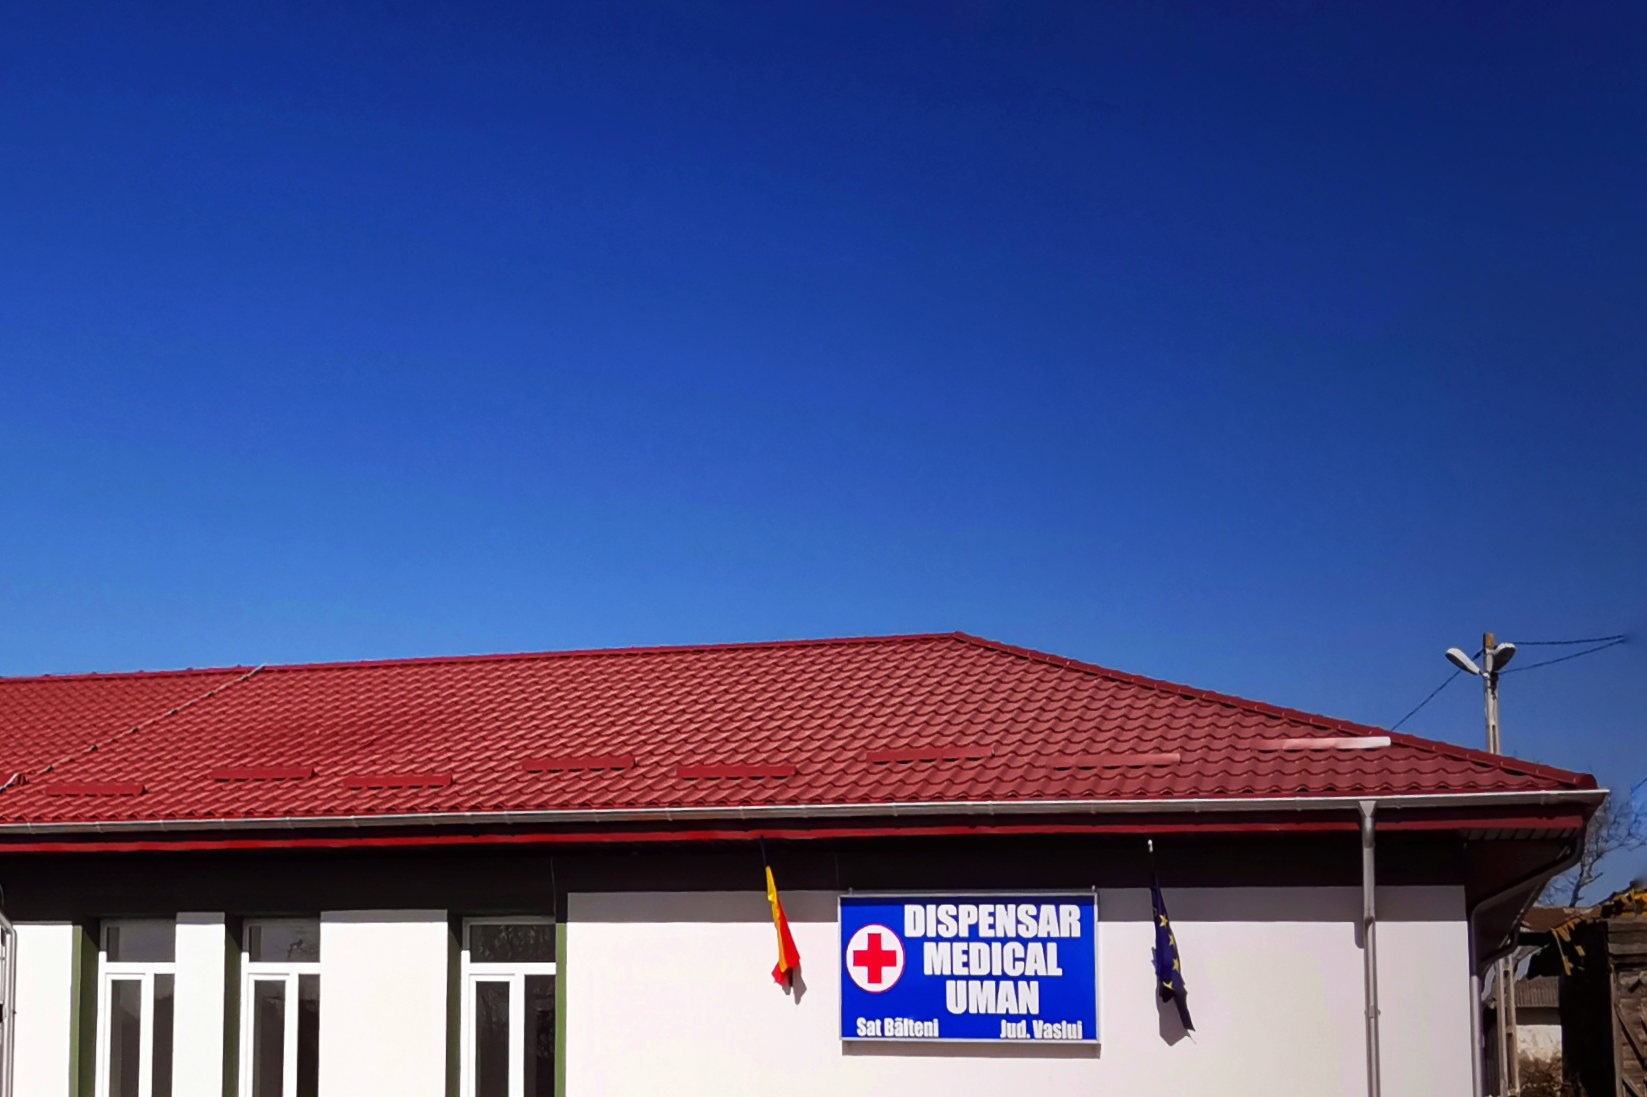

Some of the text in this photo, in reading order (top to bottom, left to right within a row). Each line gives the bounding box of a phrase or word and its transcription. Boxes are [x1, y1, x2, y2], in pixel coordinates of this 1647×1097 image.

[904, 904, 1081, 938] DISPENSAR
[923, 942, 1062, 976] MEDICAL
[946, 980, 1039, 1015] UMAN
[856, 1017, 882, 1037] Sat
[1000, 1020, 1082, 1040] Jud. Vaslui
